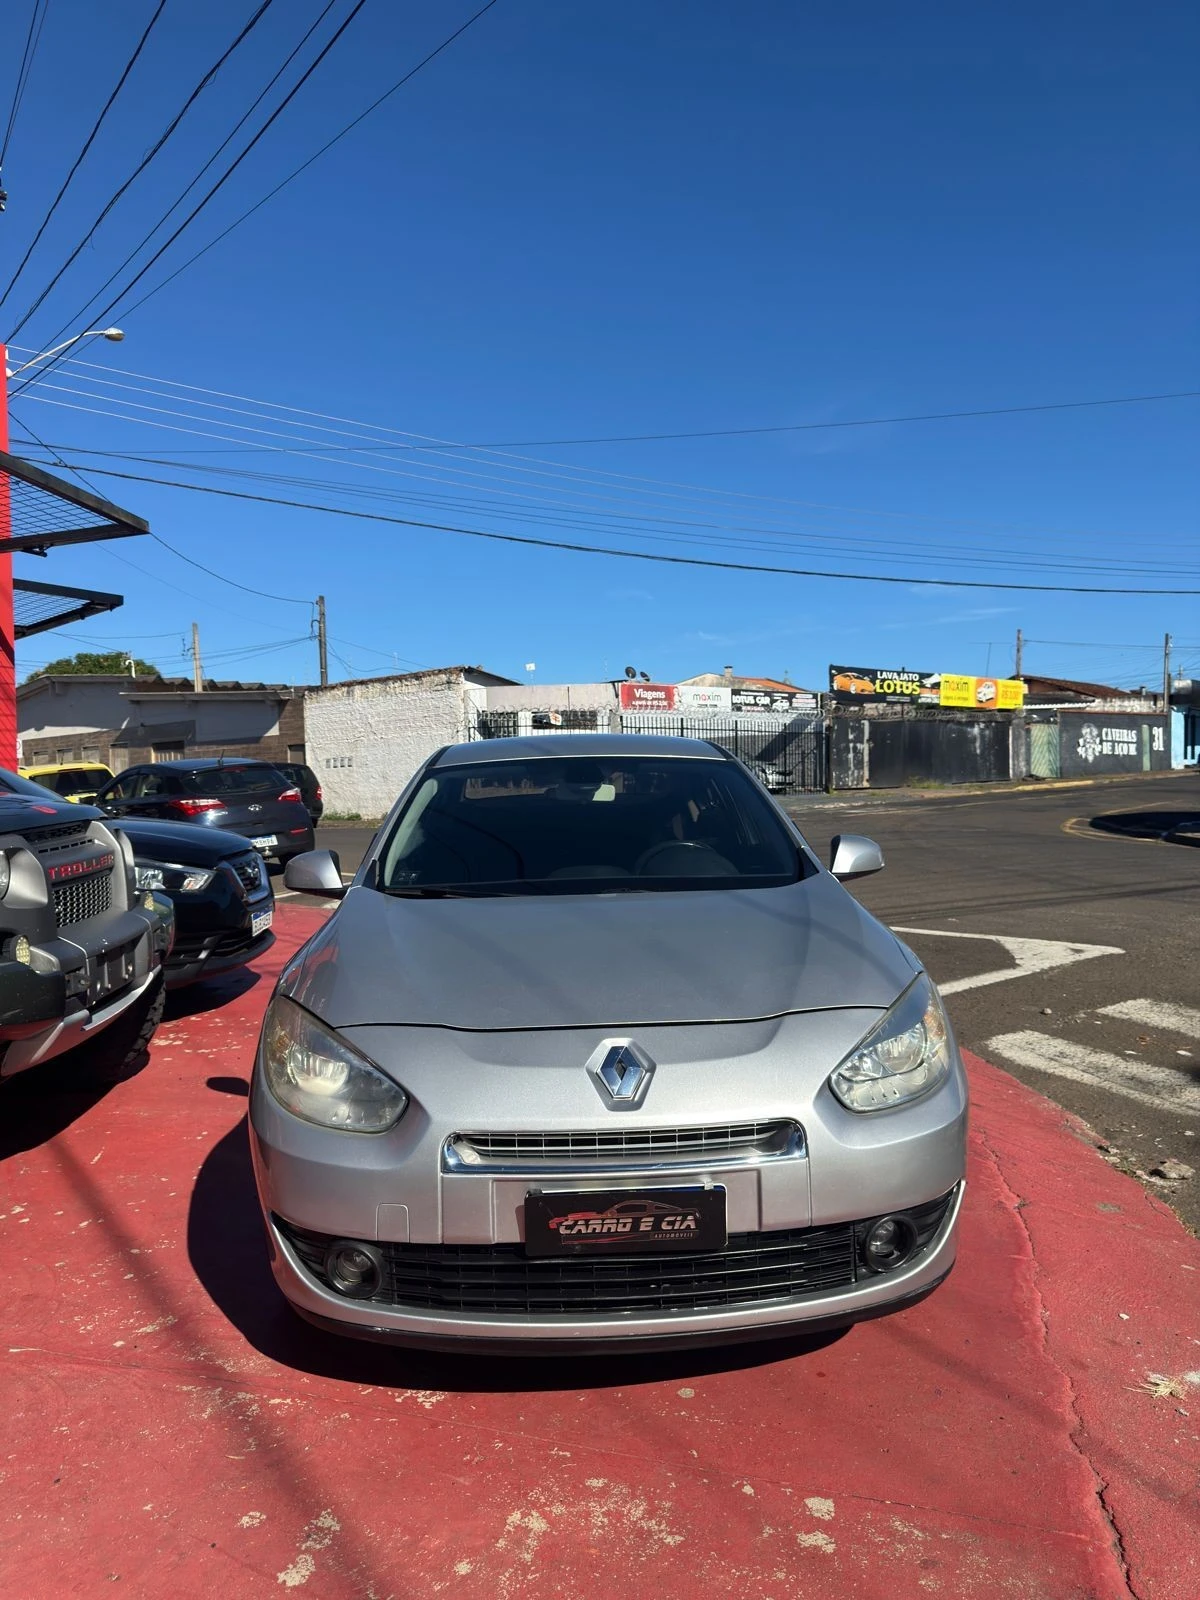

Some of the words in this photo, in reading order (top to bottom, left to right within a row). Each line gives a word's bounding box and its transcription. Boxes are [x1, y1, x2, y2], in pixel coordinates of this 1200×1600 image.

[877, 671, 899, 681] LAVA
[899, 673, 920, 682] JATO
[633, 688, 666, 700] Viagens
[875, 679, 921, 695] LOTUS
[692, 692, 722, 701] maxim
[1102, 727, 1137, 742] CAVEIRAS
[1152, 726, 1164, 750] 31
[1102, 741, 1112, 754] DE
[47, 854, 114, 880] TROLLER
[559, 1218, 633, 1235] CARRO
[639, 1216, 655, 1231] E
[660, 1215, 697, 1230] CIA
